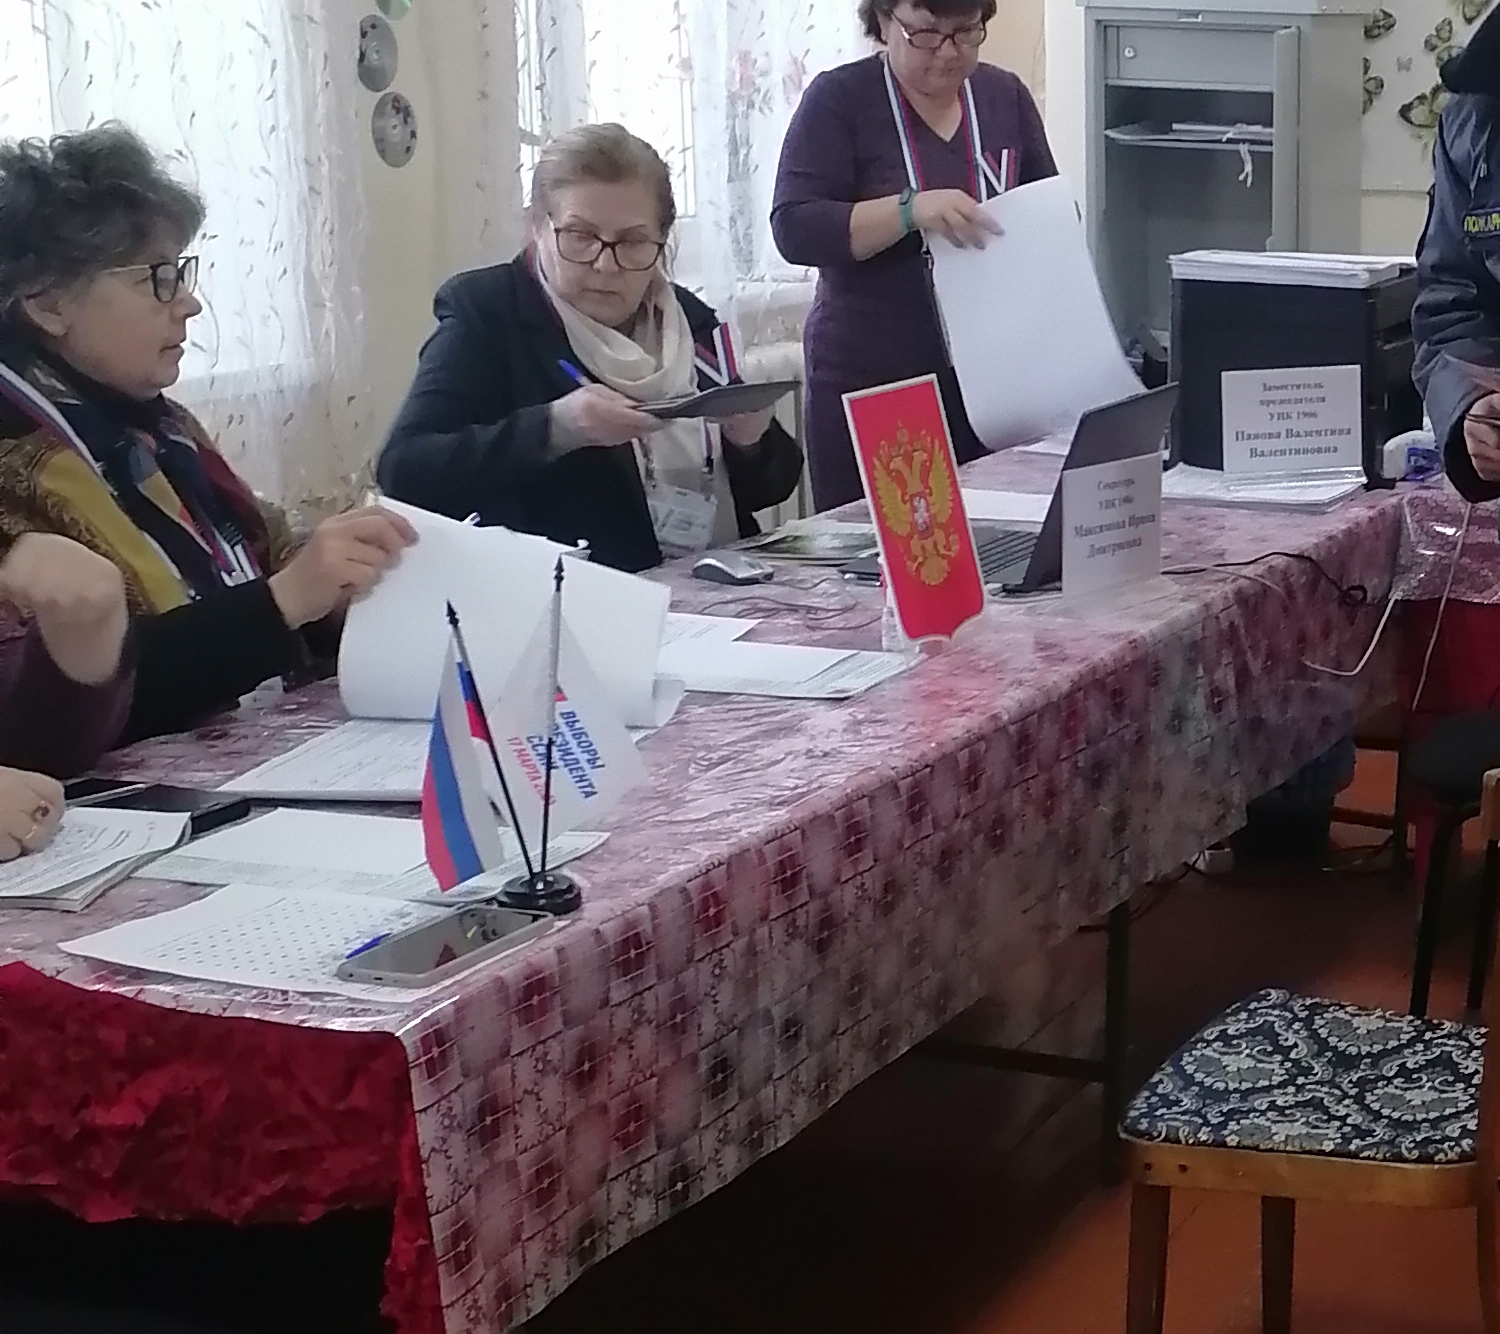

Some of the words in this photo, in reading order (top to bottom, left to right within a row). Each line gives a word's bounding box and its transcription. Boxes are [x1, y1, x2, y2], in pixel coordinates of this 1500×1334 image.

[1261, 381, 1324, 392] Заместитель
[1235, 430, 1281, 442] Панова
[1285, 427, 1352, 440] Валентина
[1249, 445, 1338, 459] Валентиновна
[559, 709, 606, 770] ВЫБОРЫ
[512, 748, 542, 782] МАРТА
[552, 723, 599, 799] РЕЗИДЕНТА
